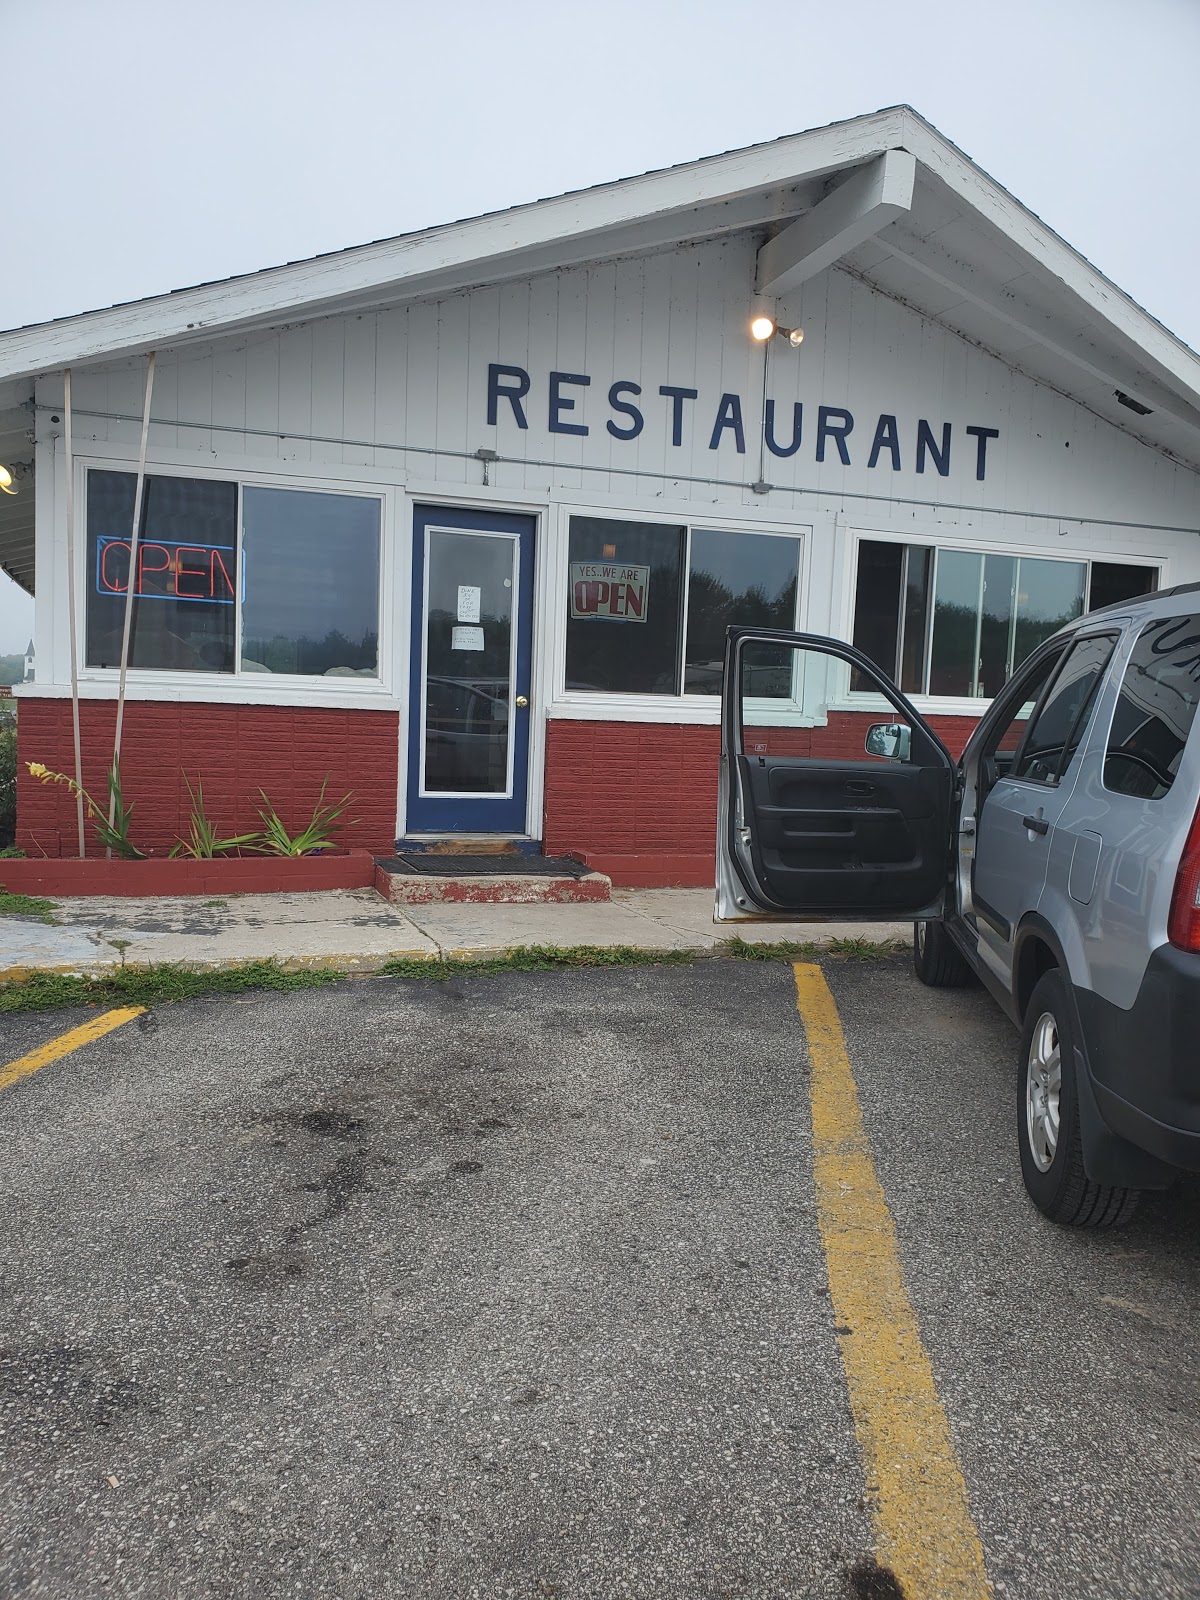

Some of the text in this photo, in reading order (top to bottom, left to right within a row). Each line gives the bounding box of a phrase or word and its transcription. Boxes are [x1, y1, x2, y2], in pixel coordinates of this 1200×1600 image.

[486, 363, 999, 481] RESTAURANT
[102, 541, 235, 598] OPEN
[620, 569, 639, 581] ARE
[574, 580, 644, 617] OPEN
